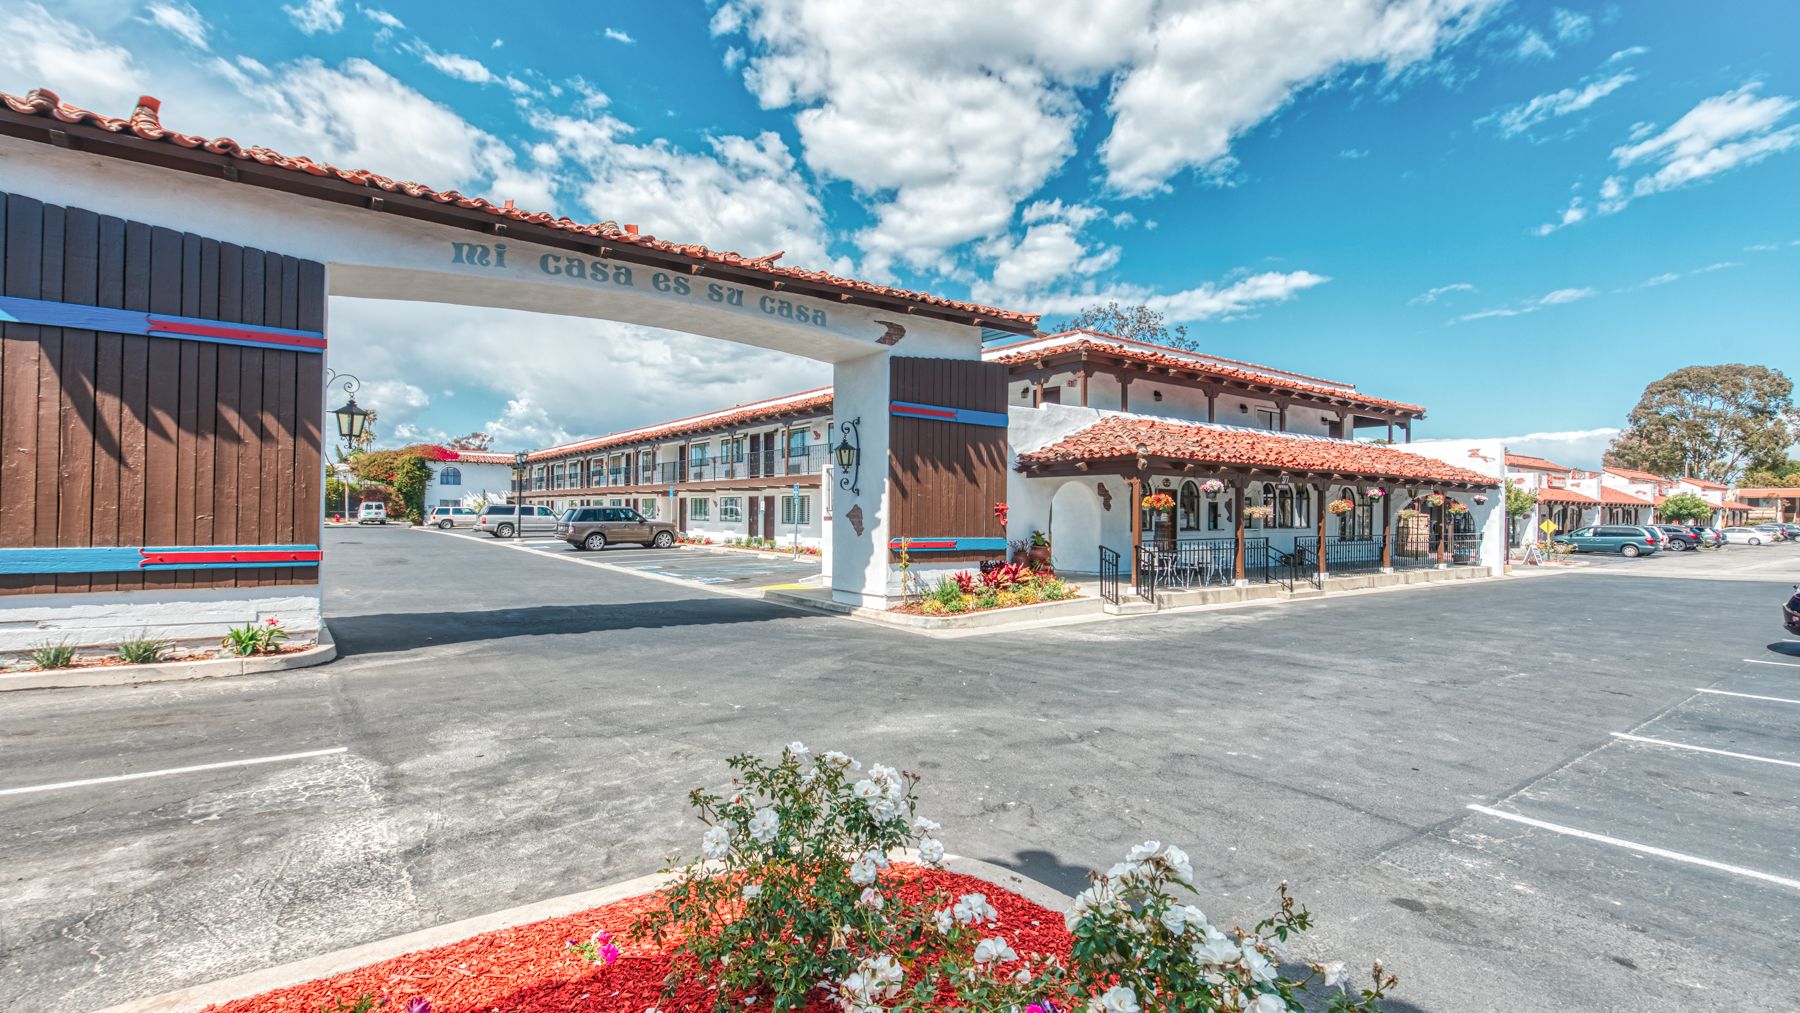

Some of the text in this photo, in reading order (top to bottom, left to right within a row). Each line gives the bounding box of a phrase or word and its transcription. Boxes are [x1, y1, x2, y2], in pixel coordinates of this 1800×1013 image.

[451, 241, 828, 329] mi casa es su casa
